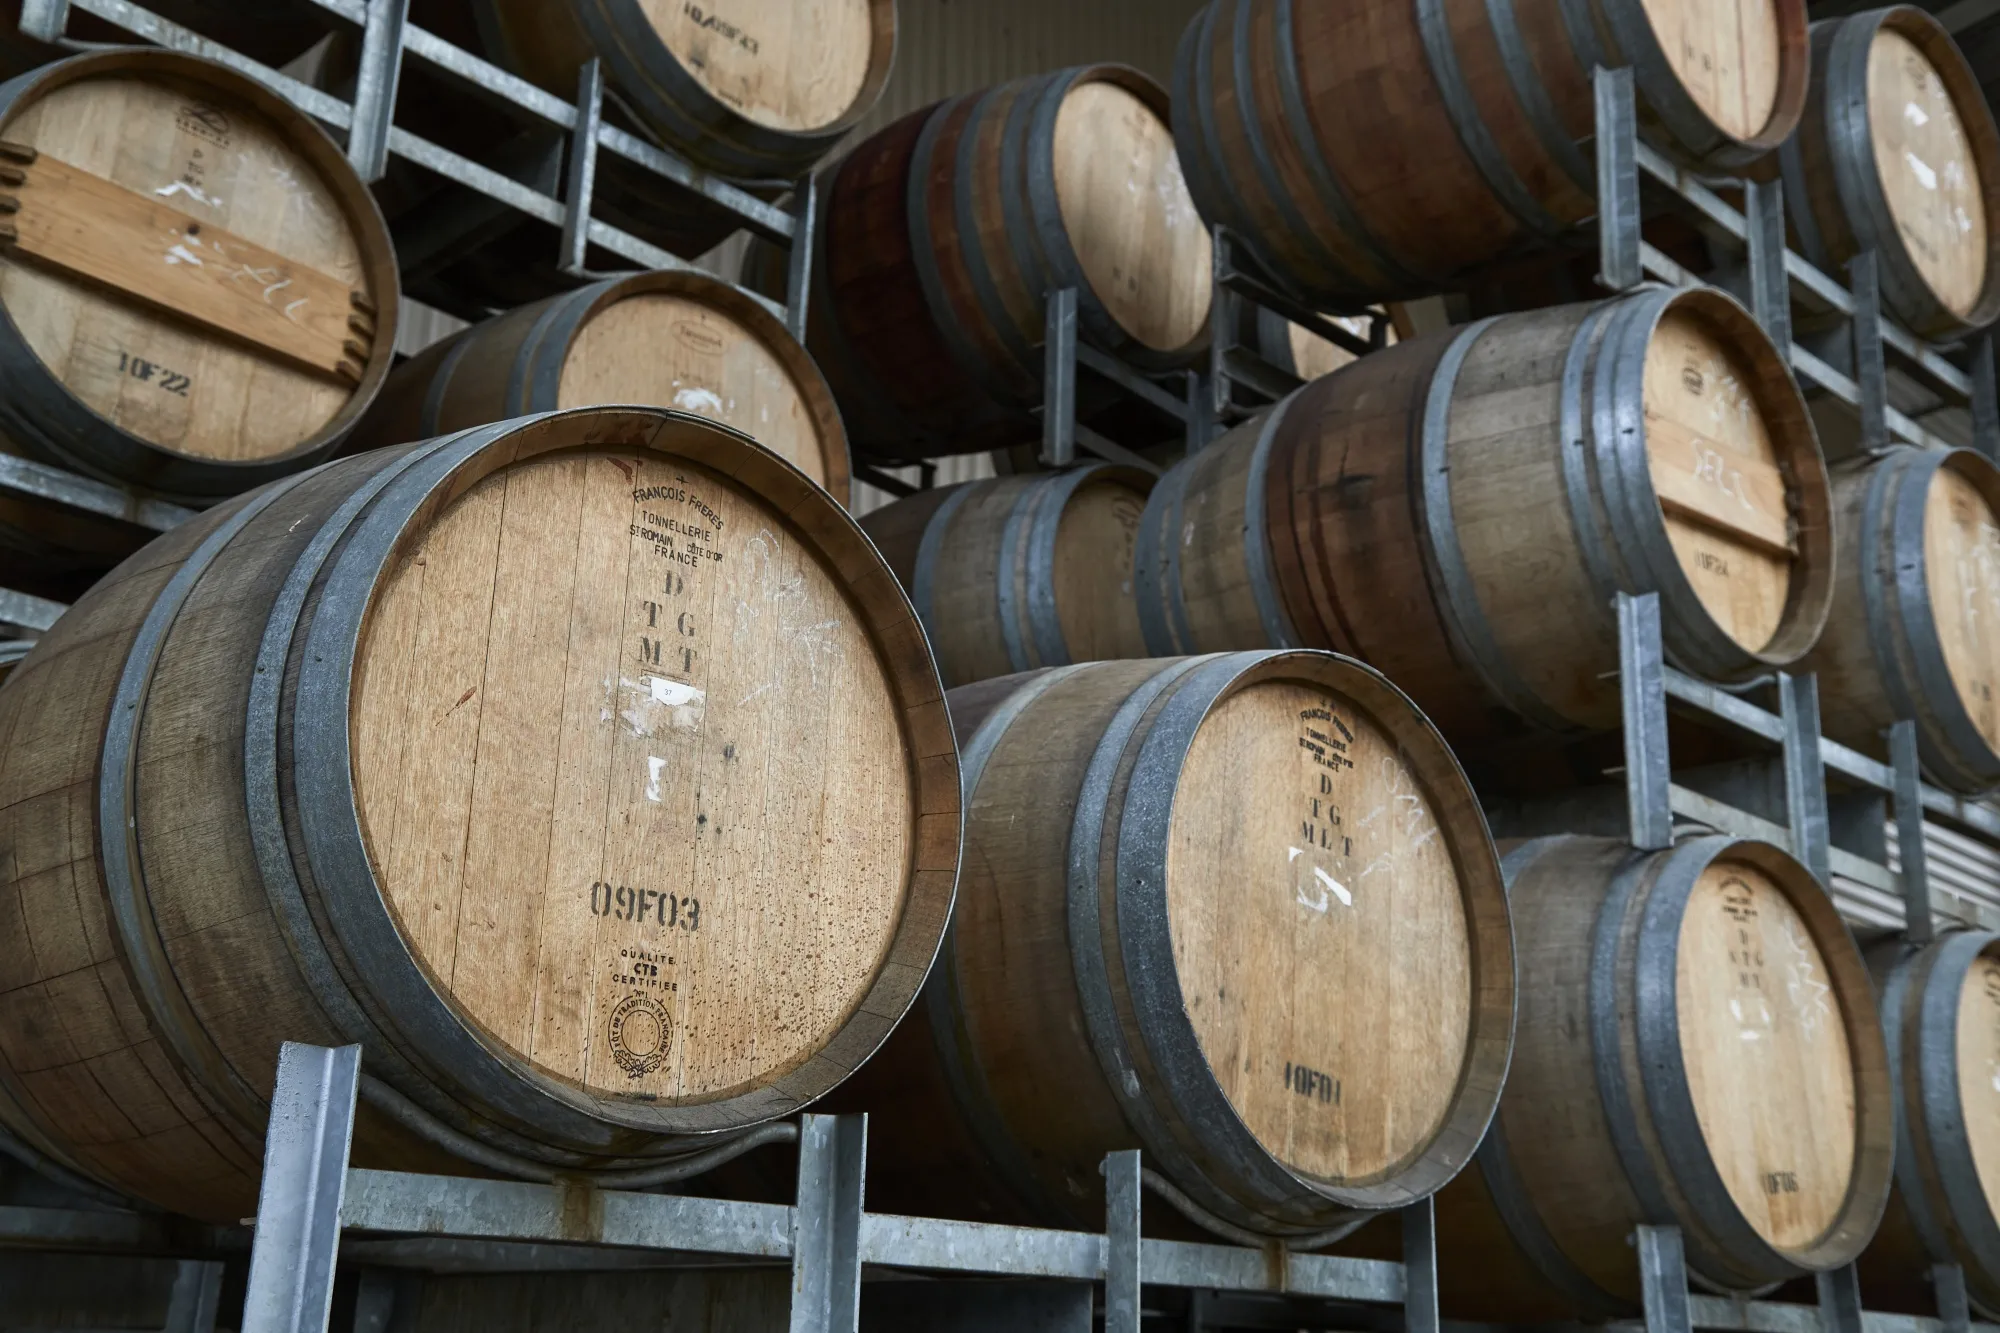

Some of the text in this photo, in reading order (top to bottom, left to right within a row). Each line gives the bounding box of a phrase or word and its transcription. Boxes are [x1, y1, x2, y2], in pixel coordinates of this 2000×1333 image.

[632, 486, 724, 530] FRANÇOIS FRERES
[640, 527, 674, 547] ROMAIN
[642, 510, 711, 542] TONNELLERIE
[655, 544, 698, 568] FRANCE
[663, 570, 684, 597] D
[643, 600, 695, 638] T G
[638, 636, 698, 673] M T
[591, 881, 700, 932] 09F03
[620, 948, 674, 965] QUALITE
[633, 963, 658, 977] CTB
[612, 974, 678, 992] CERTIFIEE
[617, 998, 656, 1016] TRADITION
